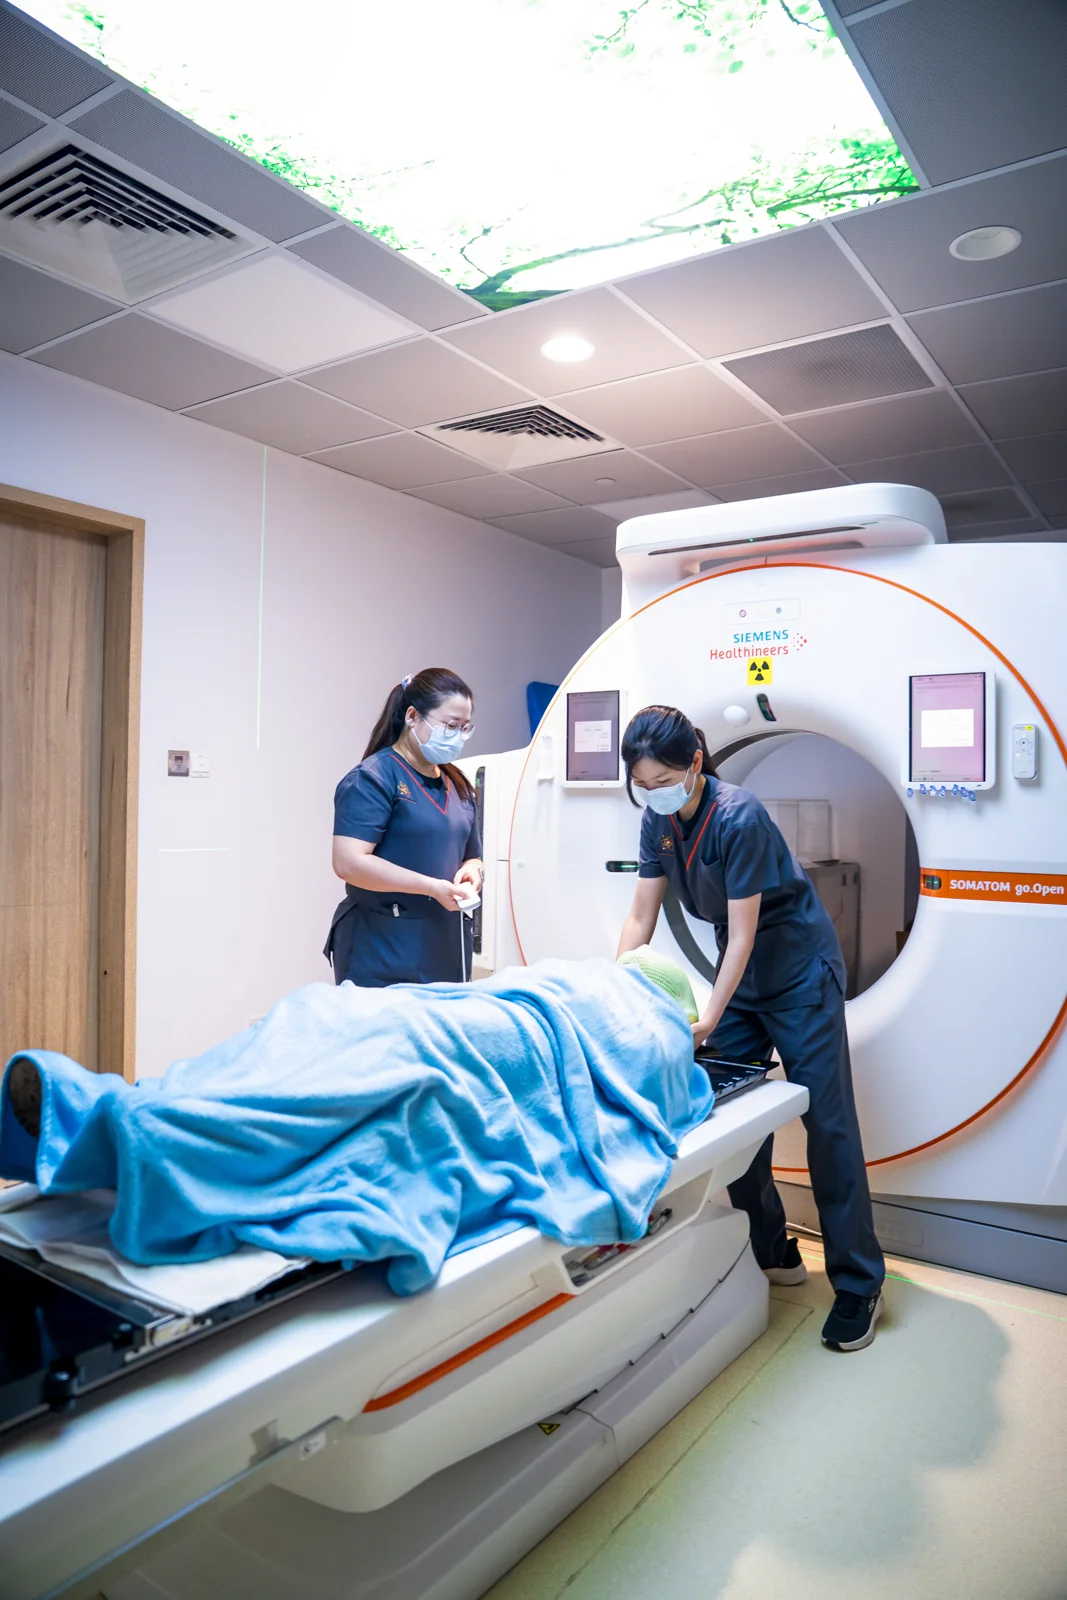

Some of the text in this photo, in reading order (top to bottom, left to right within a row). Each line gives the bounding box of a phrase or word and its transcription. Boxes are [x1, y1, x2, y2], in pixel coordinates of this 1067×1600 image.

[733, 629, 789, 643] SIEMENS
[710, 645, 789, 660] Healthineers
[949, 879, 1064, 896] SOMATOM go.Open
